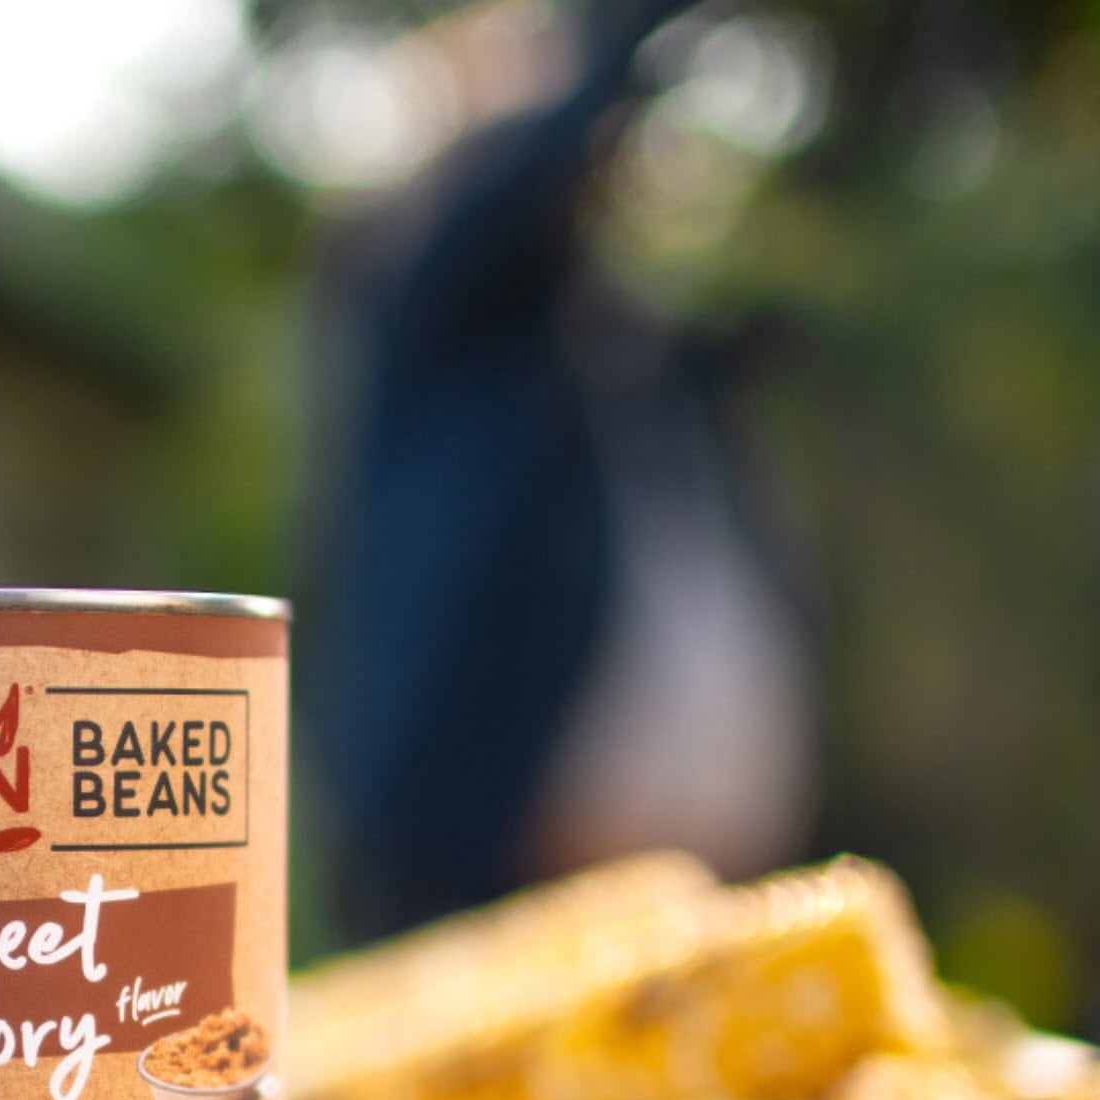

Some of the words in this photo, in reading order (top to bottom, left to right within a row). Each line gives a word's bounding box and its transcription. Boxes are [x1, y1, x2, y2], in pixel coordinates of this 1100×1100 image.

[72, 720, 231, 766] BAKED
[72, 769, 231, 818] BEANS
[115, 976, 188, 1023] flavor
